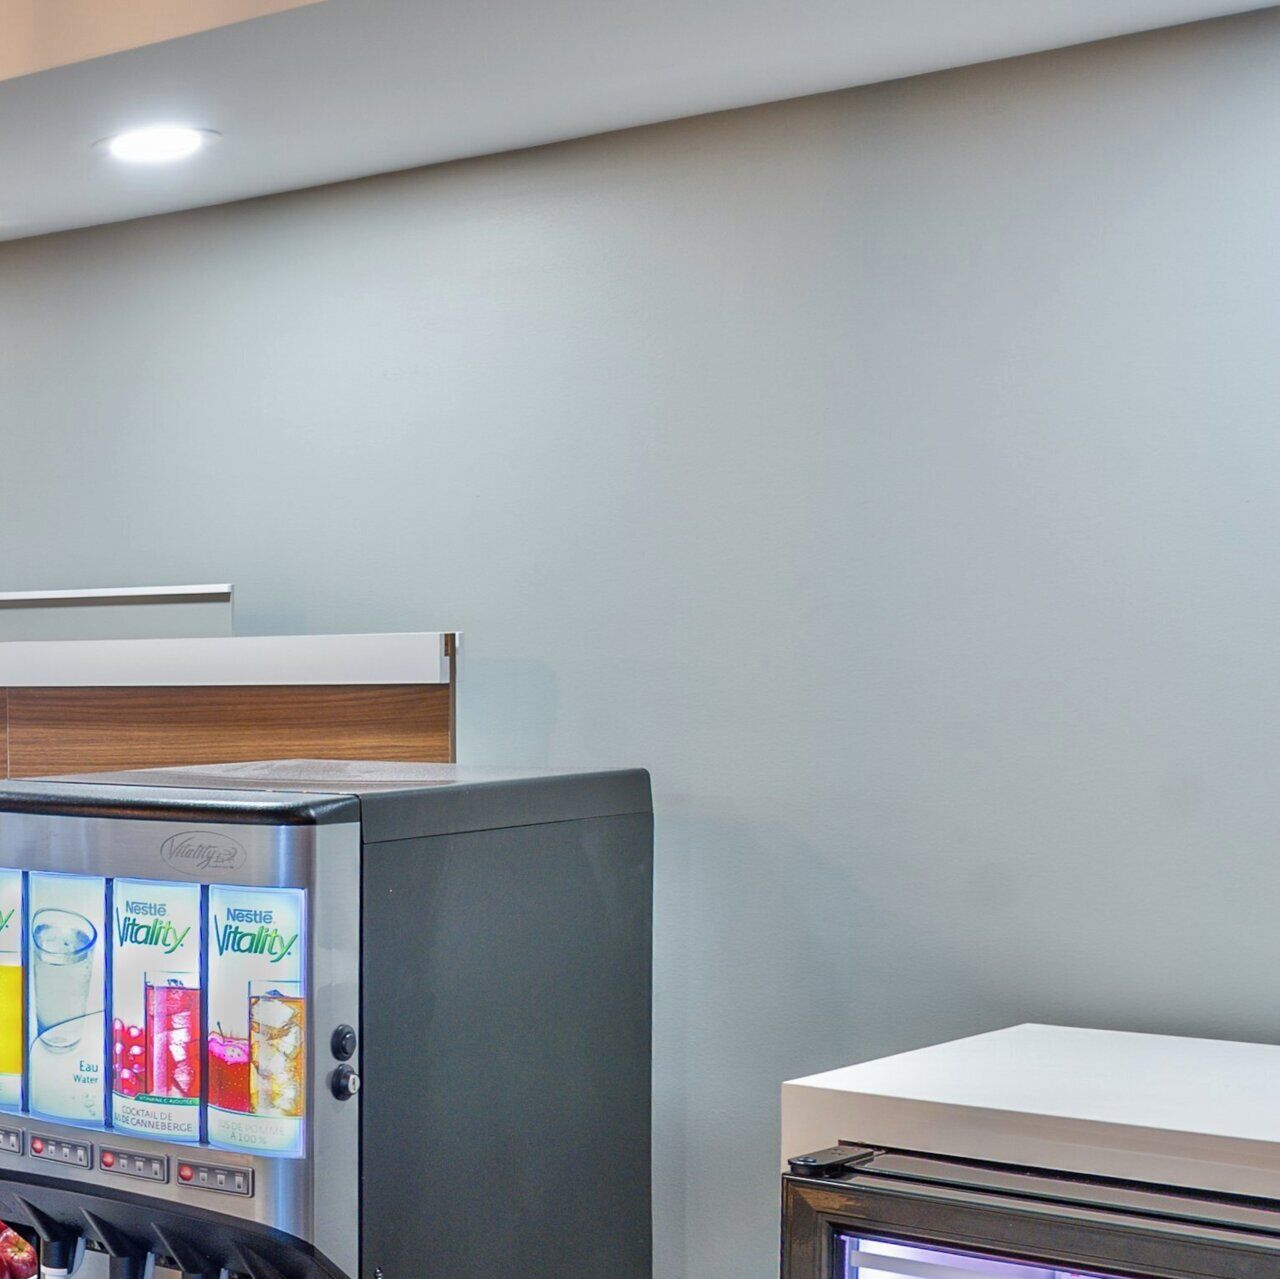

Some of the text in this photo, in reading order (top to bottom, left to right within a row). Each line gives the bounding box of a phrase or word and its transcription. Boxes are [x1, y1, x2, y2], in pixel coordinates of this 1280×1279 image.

[125, 900, 167, 917] Nestlé
[226, 907, 273, 924] Nestlé
[115, 906, 191, 955] Vitality
[214, 914, 299, 963] Vitality
[79, 1060, 99, 1073] Eau
[72, 1074, 98, 1084] Water
[121, 1104, 173, 1121] COCKTAIL DE
[131, 1117, 193, 1132] CANNEBERGE
